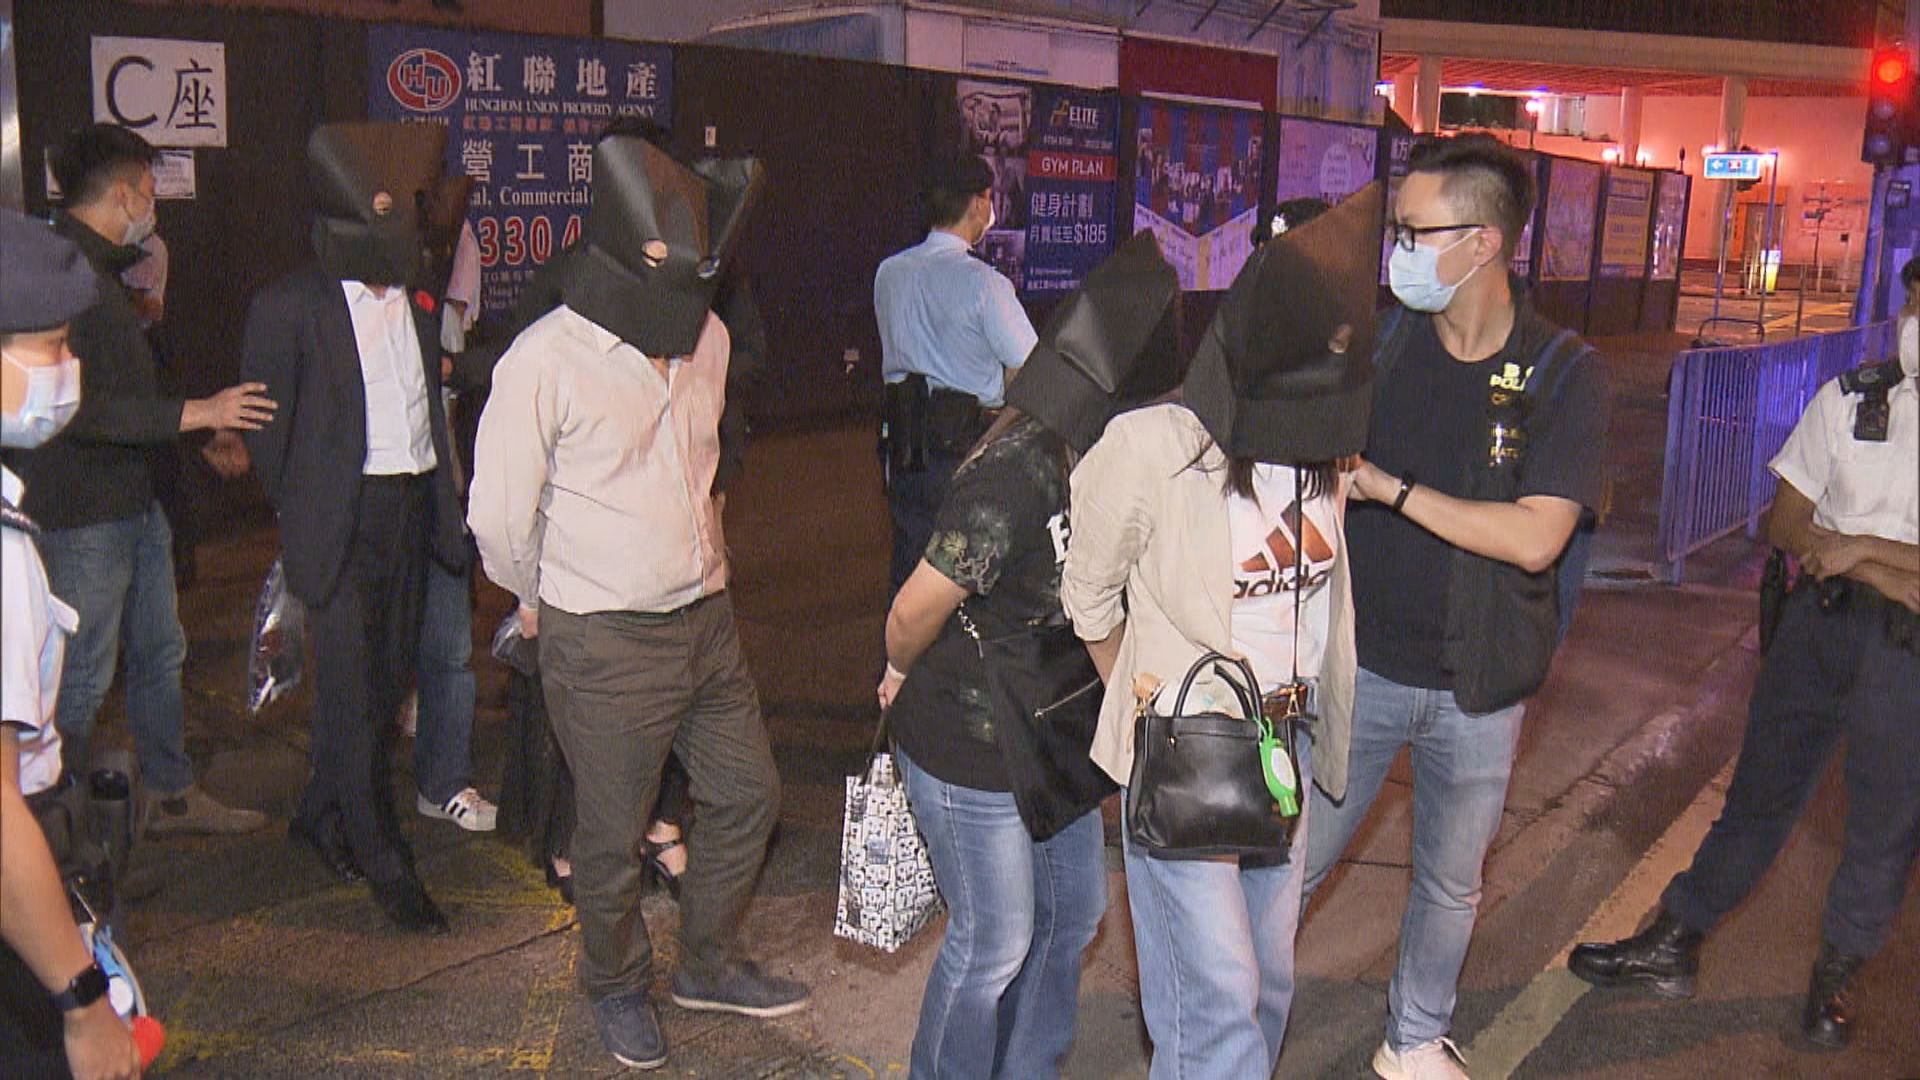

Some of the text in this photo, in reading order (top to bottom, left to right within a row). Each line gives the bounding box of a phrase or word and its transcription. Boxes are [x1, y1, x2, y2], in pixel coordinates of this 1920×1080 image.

[466, 51, 656, 99] 紅聯地產
[527, 100, 558, 114] UNION
[563, 102, 612, 116] PROPERTY
[1041, 156, 1104, 177] GYM PLAN
[500, 186, 588, 206] Commercial
[1233, 565, 1330, 599] adida
